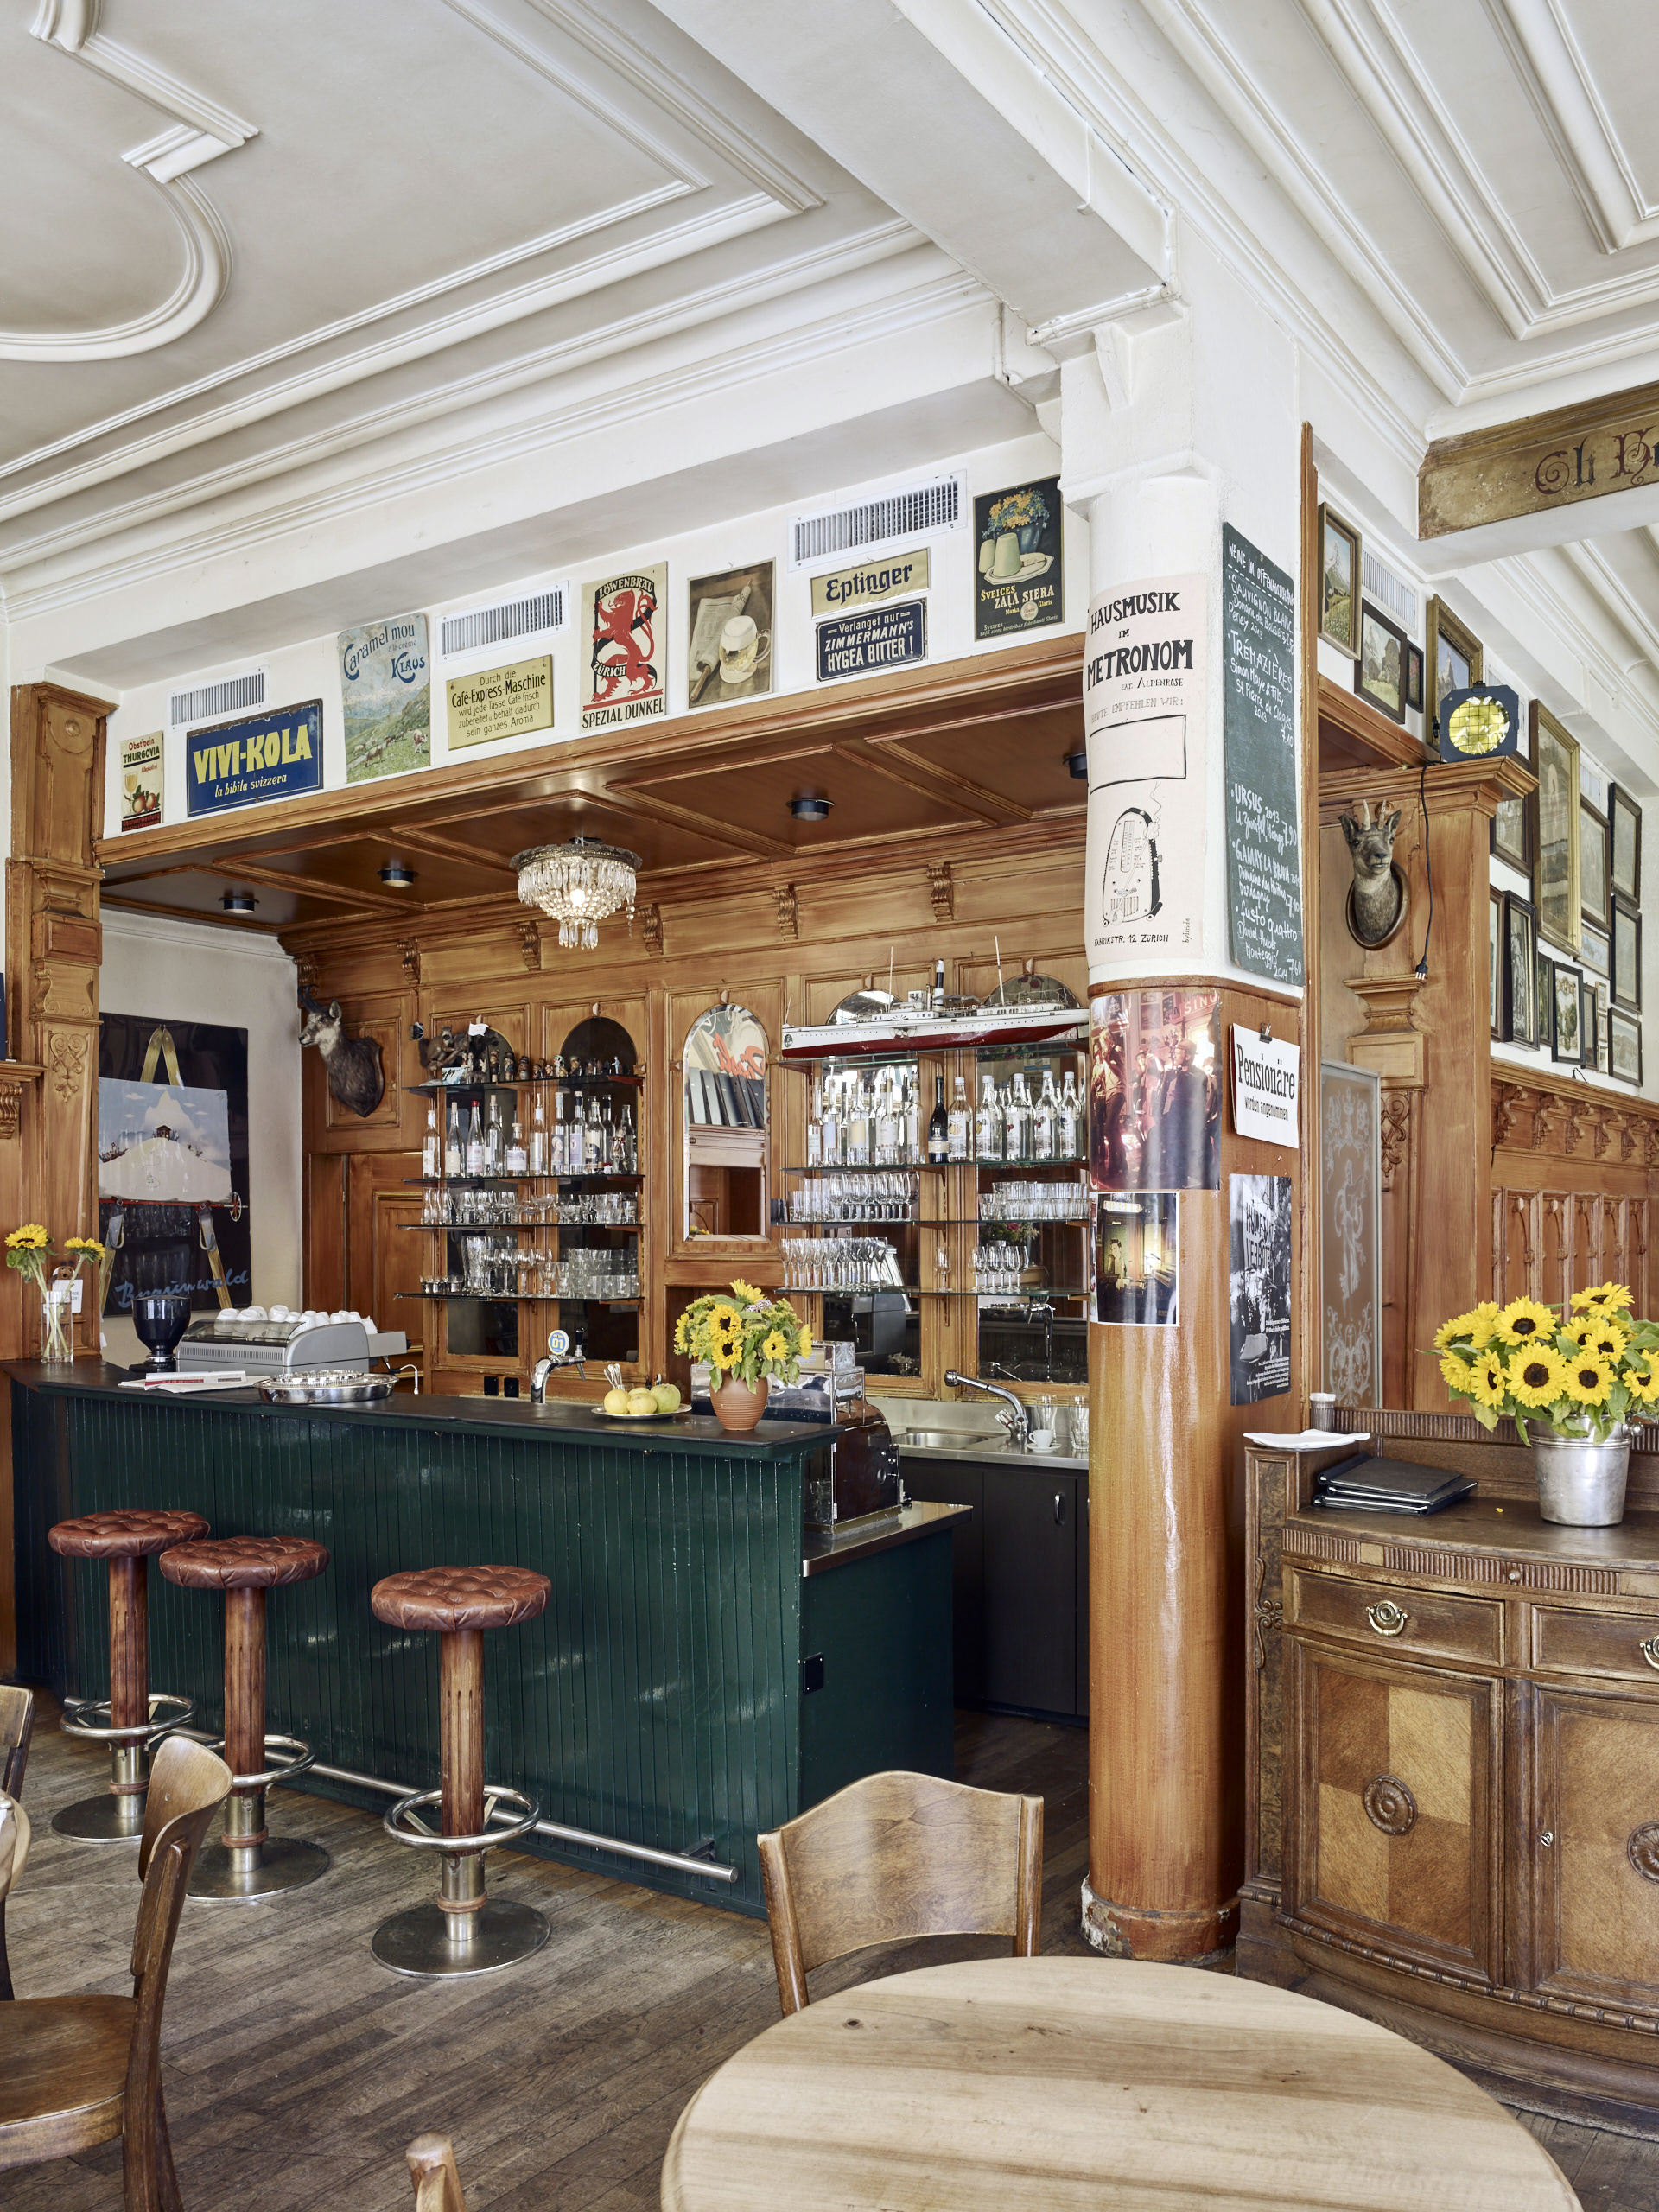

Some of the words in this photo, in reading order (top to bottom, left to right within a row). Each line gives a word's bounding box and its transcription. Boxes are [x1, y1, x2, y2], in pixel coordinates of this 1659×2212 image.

[1229, 539, 1246, 569] WEINE
[599, 576, 654, 598] LÖWENBRÄU
[825, 563, 912, 606] Eptinger
[1022, 584, 1055, 603] SIERA
[1090, 591, 1181, 636] HAUSMUSIK
[1230, 573, 1272, 620] SAUVIGNON
[1273, 607, 1294, 633] BLANC
[838, 614, 881, 634] Verlanget
[884, 612, 900, 624] nur
[1117, 628, 1130, 639] IM
[343, 626, 389, 681] Caramel
[391, 624, 415, 641] mou
[827, 645, 865, 672] HYGEA
[868, 637, 906, 664] BITTER
[1087, 639, 1194, 692] METRONOM
[480, 672, 501, 686] Durch
[505, 670, 517, 680] die
[593, 661, 626, 677] ZÜRICH
[1230, 657, 1249, 681] Simon
[458, 707, 472, 717] wird
[473, 703, 487, 717] jede
[488, 699, 506, 711] Tasse
[522, 689, 540, 702] frisch
[458, 714, 488, 728] zubereitet
[515, 701, 540, 715] dadurch
[582, 706, 623, 729] SPEZIAL
[625, 696, 664, 721] DUNKEL
[467, 727, 480, 738] sein
[484, 721, 508, 736] ganzes
[510, 715, 534, 728] Aroma
[123, 745, 161, 764] THURGOVIA
[192, 724, 313, 785] VIVI-KOLA
[214, 785, 223, 798] la
[225, 779, 248, 796] bibita
[250, 774, 287, 790] svizzera
[1234, 782, 1262, 814] URSUS
[1264, 806, 1280, 824] 2013
[1236, 837, 1262, 872] GAMAY
[1128, 933, 1137, 944] 12
[1236, 1043, 1295, 1100] Pensionäre
[551, 1338, 563, 1350] 01
